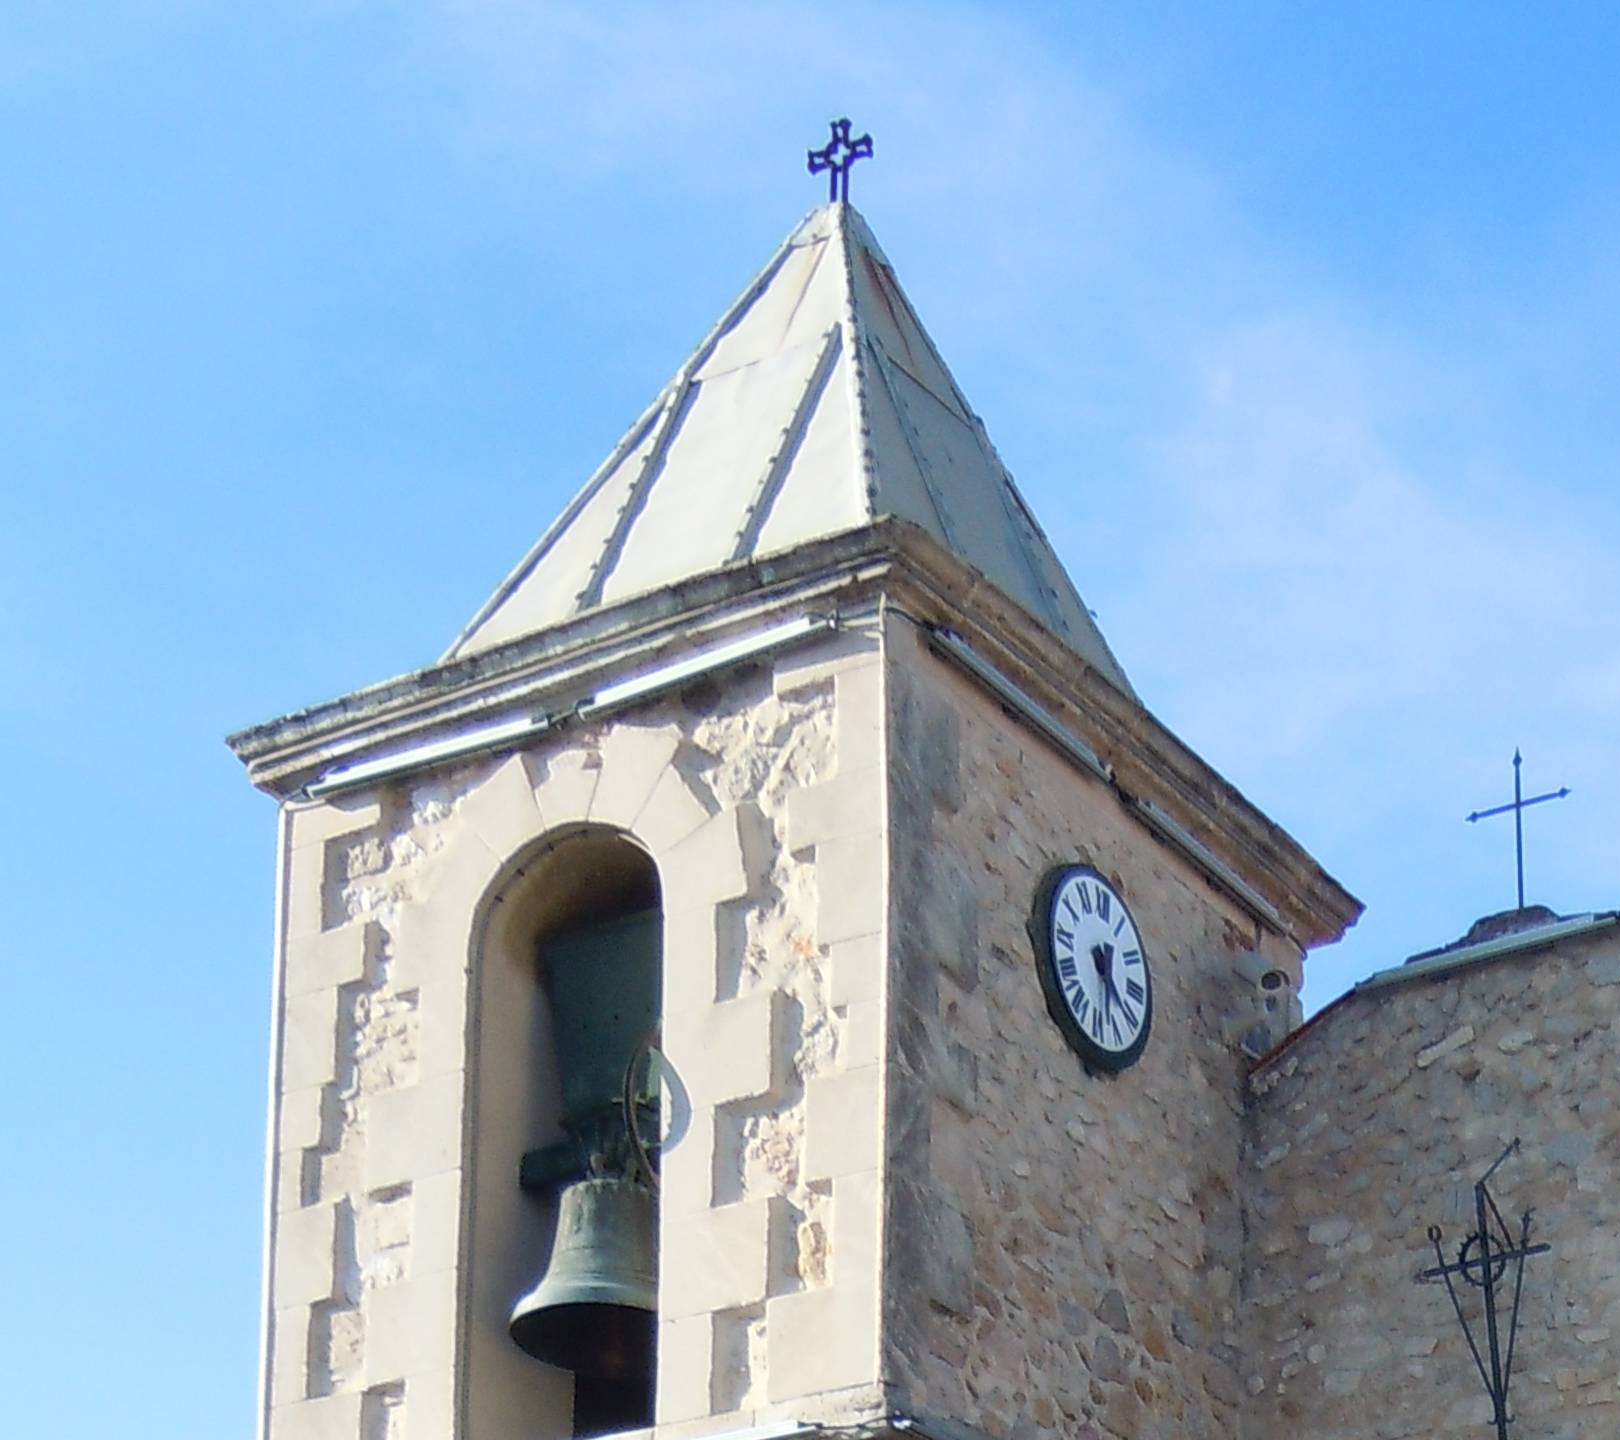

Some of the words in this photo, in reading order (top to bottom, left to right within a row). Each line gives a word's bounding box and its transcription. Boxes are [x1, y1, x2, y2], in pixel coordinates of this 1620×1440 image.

[1062, 894, 1080, 926] X
[1075, 881, 1092, 914] XI
[1095, 884, 1110, 924] XII
[1056, 920, 1074, 953] IX
[1114, 916, 1126, 938] I
[1059, 956, 1080, 992] VIII
[1122, 949, 1141, 966] II
[1072, 985, 1090, 1024] VII
[1126, 976, 1144, 1006] III
[1111, 1013, 1123, 1046] V
